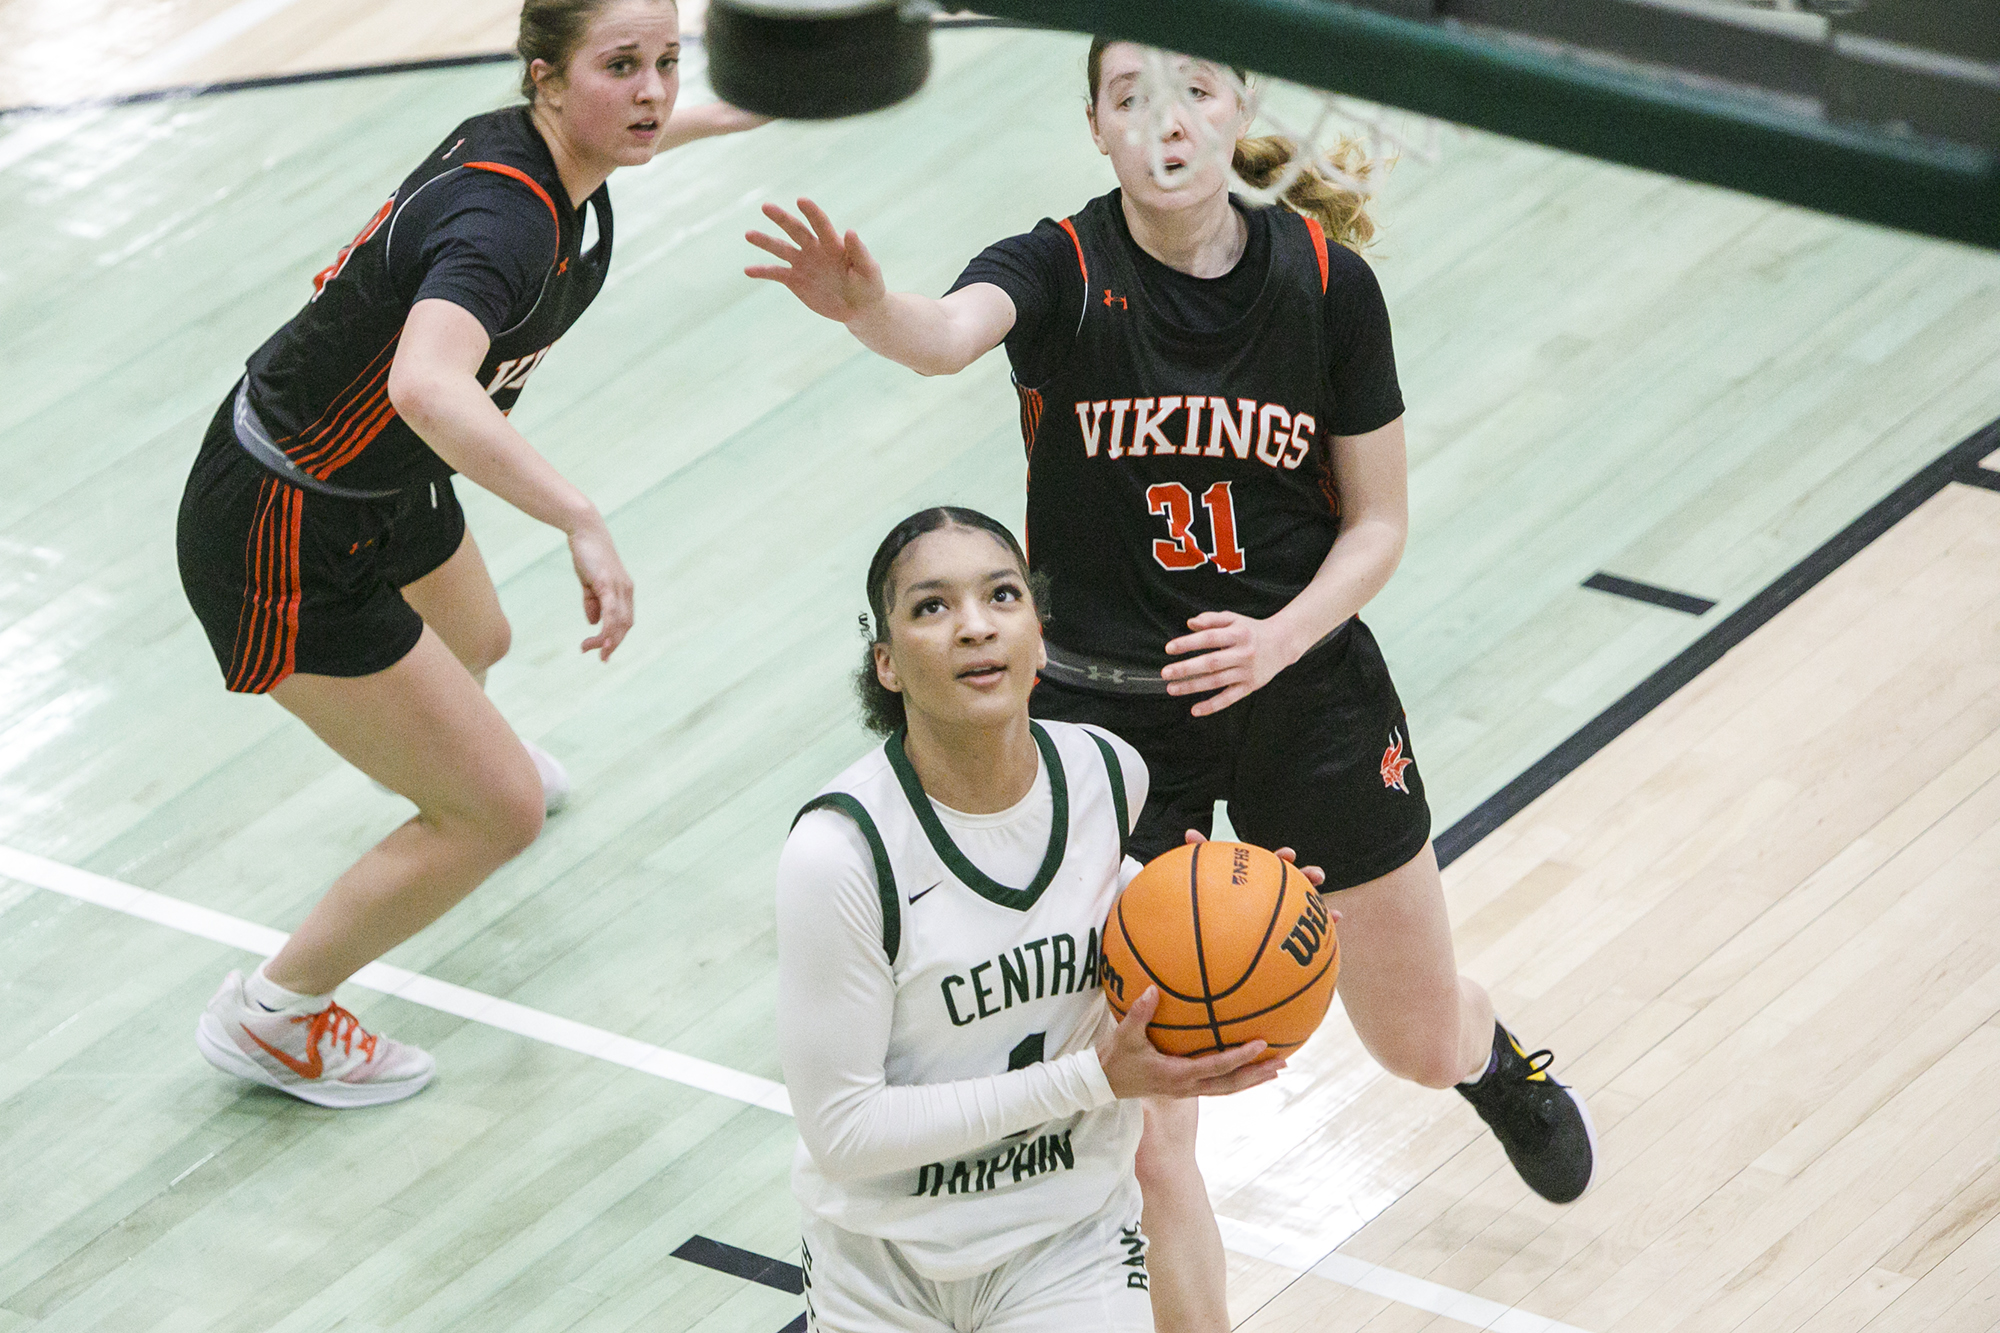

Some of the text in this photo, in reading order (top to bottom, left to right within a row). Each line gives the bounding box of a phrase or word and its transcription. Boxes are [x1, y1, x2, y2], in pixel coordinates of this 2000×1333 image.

[1075, 395, 1316, 469] VIKINGS
[1146, 481, 1245, 574] 31
[1233, 847, 1250, 876] NFHS
[1280, 890, 1328, 967] Wil
